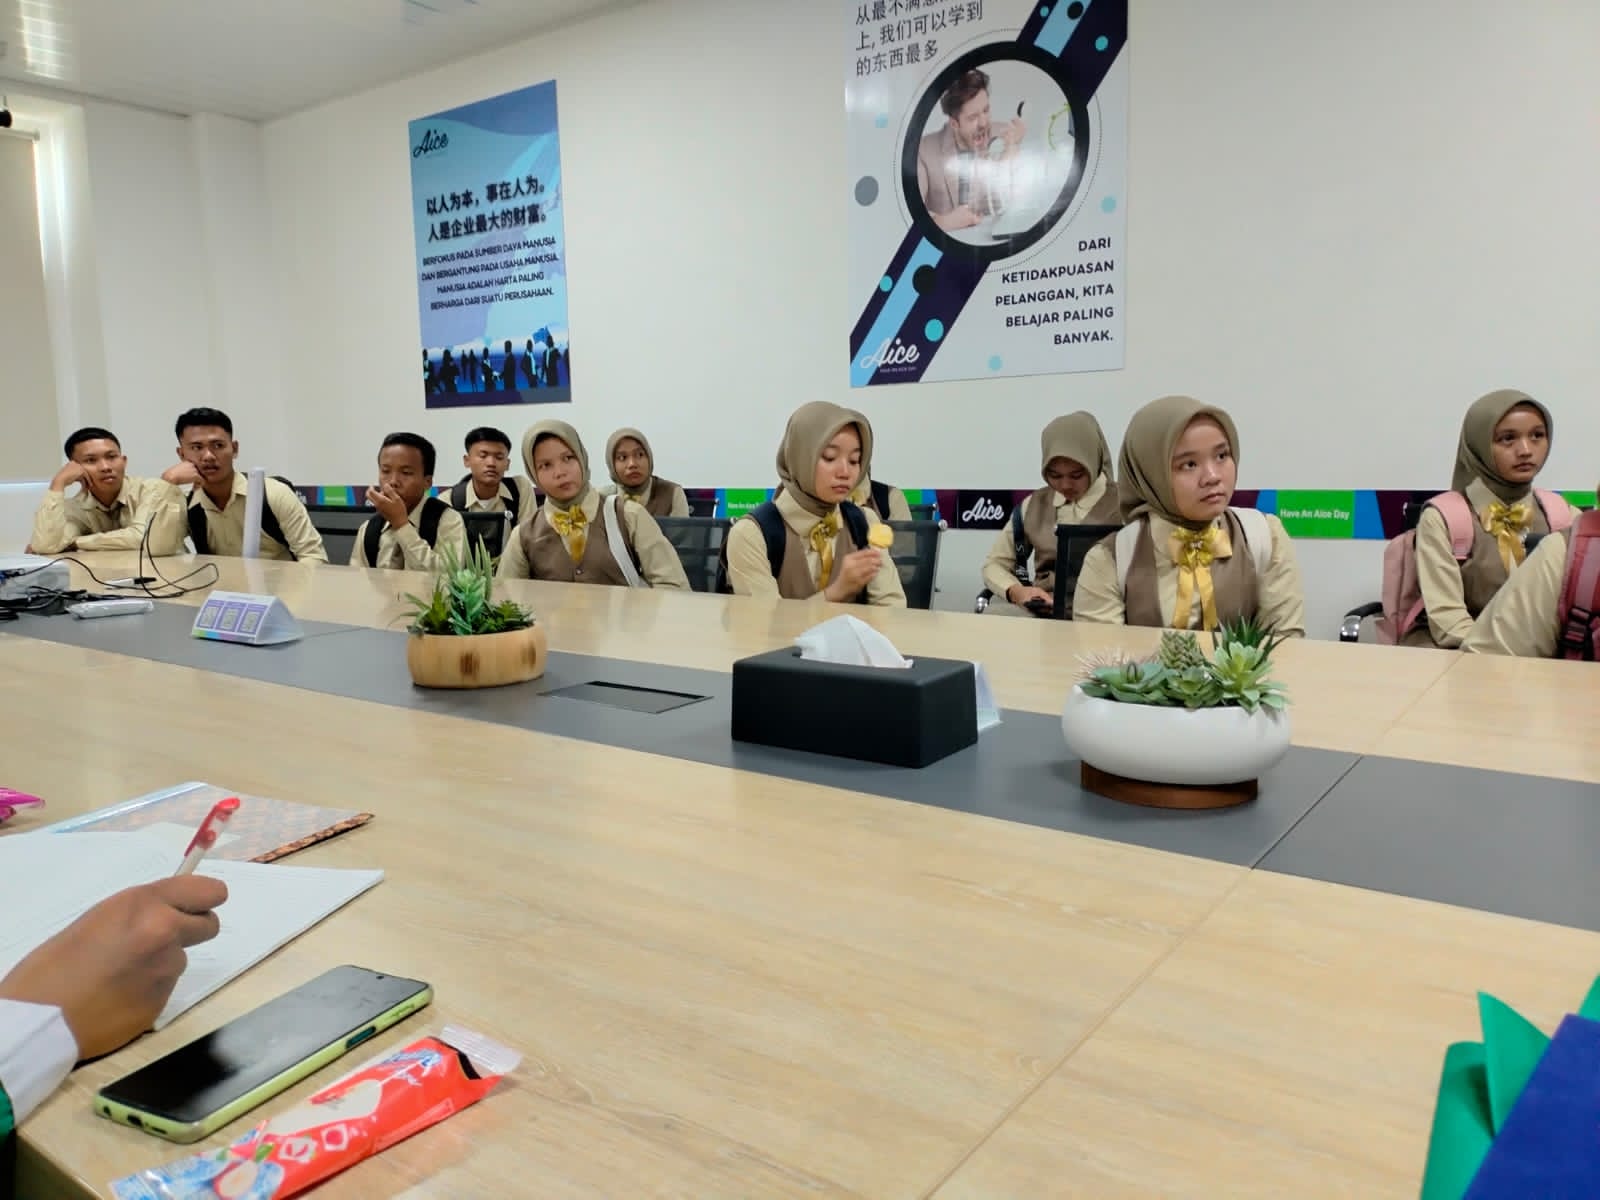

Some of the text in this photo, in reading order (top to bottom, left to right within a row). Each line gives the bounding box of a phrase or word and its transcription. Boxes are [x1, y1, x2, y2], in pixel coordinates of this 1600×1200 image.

[856, 40, 938, 76] 的东西最多
[413, 129, 449, 158] Aice
[423, 236, 556, 266] BERFOKUS PADA SUMBER DAYA MANUSIA
[1078, 237, 1111, 252] DARI
[422, 271, 436, 281] DAN
[436, 266, 480, 280] BERGANTUNG
[481, 262, 499, 273] PADA
[500, 258, 523, 270] USAHA
[1001, 259, 1114, 284] KETIDAKPUASAN
[437, 271, 545, 294] MANUSIA ADALAH HARTA PALING
[430, 299, 464, 311] BERHARGA
[465, 296, 480, 306] DARI
[481, 293, 504, 305] SUATU
[995, 283, 1114, 307] PELANGGAN, KITA
[1005, 306, 1114, 328] BELAJAR PALING
[1053, 329, 1113, 345] BANYAK.
[860, 337, 920, 368] Aice
[961, 496, 1005, 522] Aice
[1280, 508, 1300, 518] Have
[1301, 509, 1313, 518] An
[1333, 509, 1350, 521] Day
